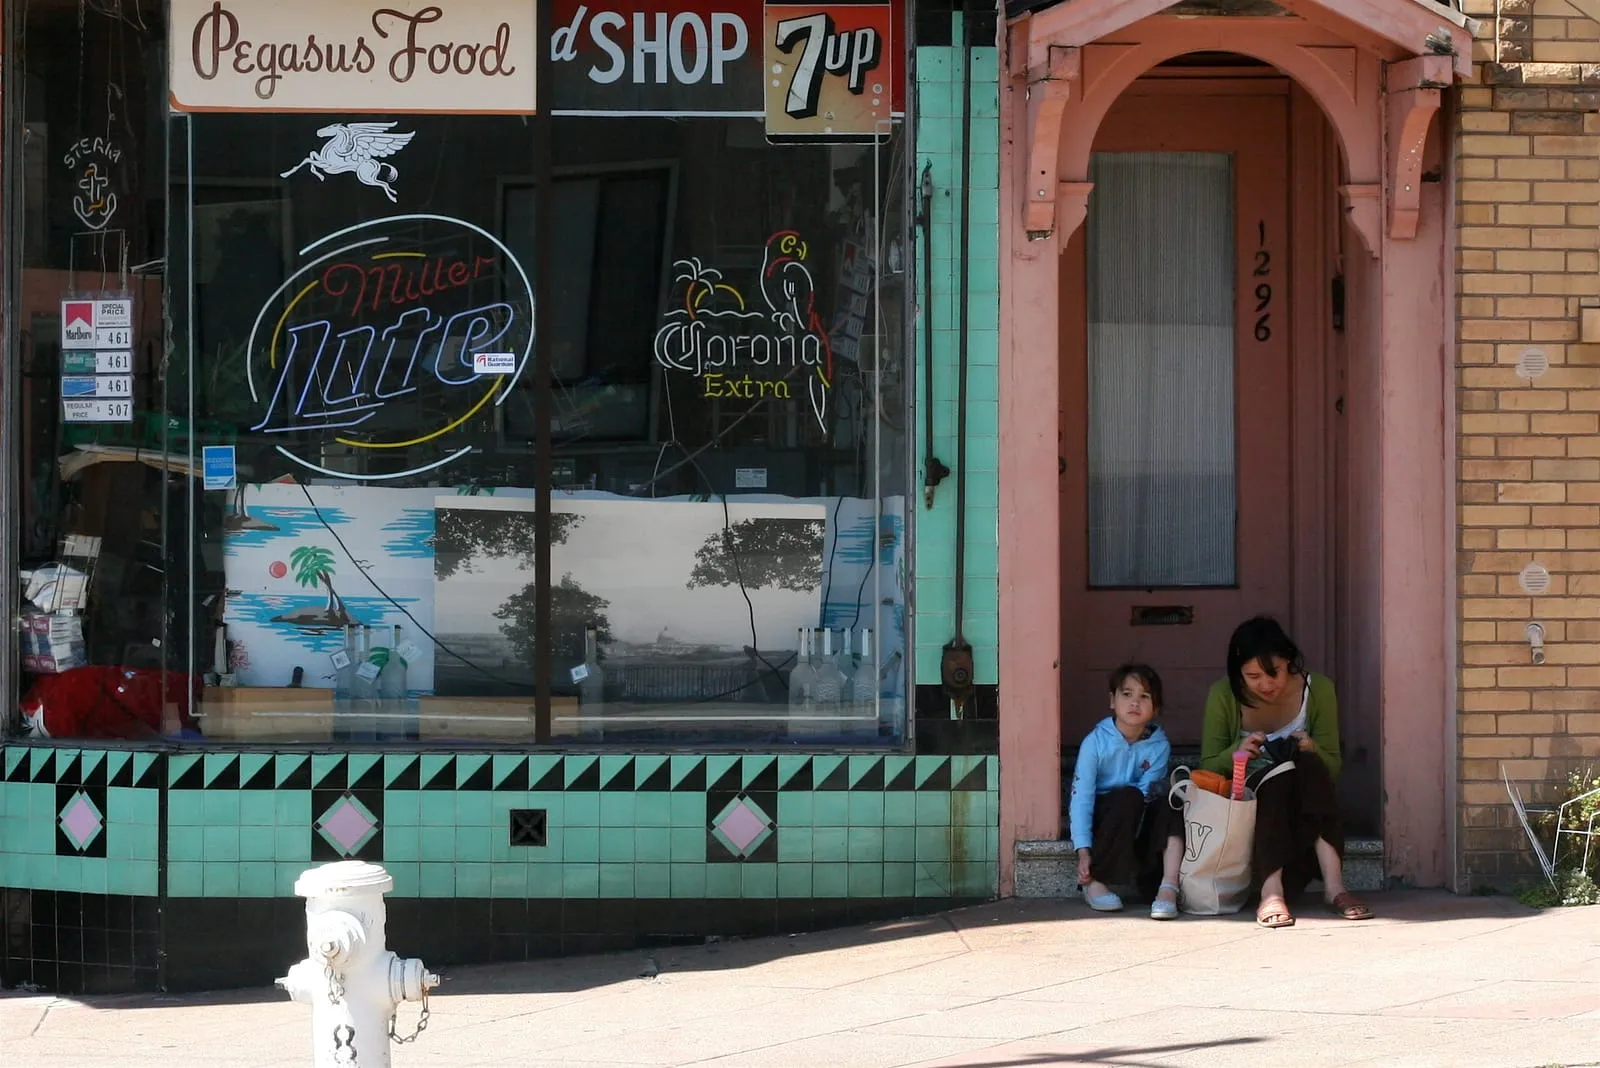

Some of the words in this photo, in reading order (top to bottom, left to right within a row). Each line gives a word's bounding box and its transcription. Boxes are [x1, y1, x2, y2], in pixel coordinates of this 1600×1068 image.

[192, 1, 376, 100] Pegasus
[372, 6, 516, 83] Food
[588, 10, 749, 85] SHOP
[323, 256, 501, 317] Miller
[1252, 218, 1272, 342] 1296
[65, 326, 93, 341] Marlboro
[654, 320, 823, 377] Corona
[108, 404, 129, 417] 507
[703, 373, 791, 399] Extra
